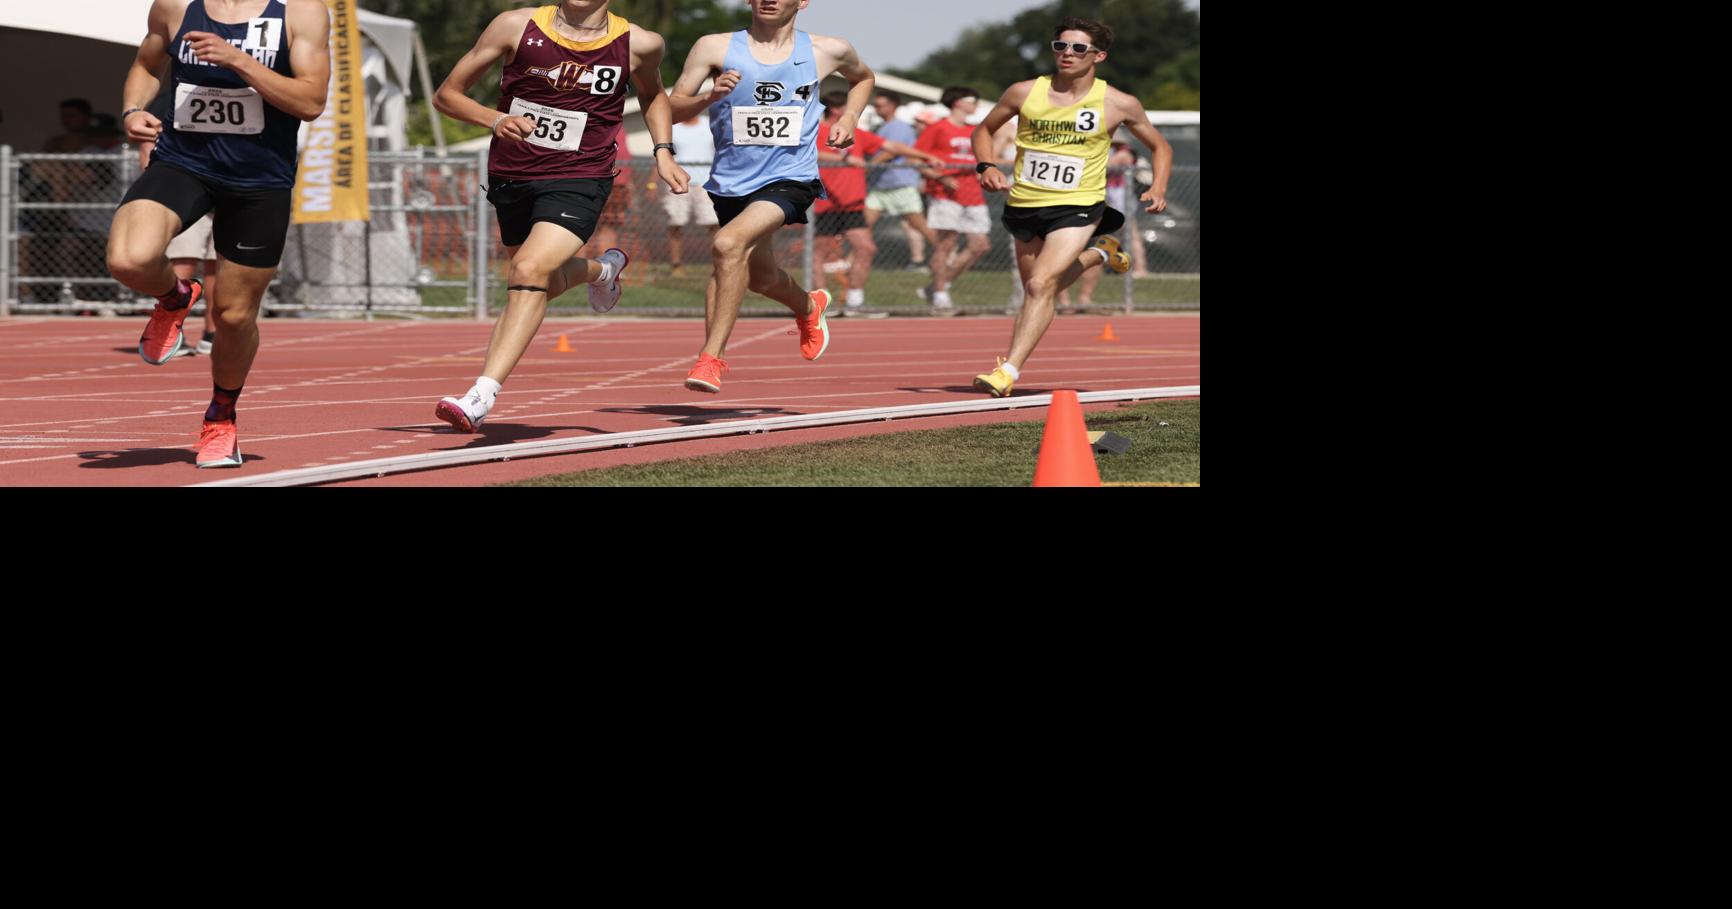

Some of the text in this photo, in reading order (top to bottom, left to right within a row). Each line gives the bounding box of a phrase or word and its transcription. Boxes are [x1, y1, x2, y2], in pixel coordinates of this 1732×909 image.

[254, 20, 270, 47] 1
[594, 68, 616, 93] 8
[795, 85, 810, 99] 4
[190, 98, 245, 125] 230
[1079, 111, 1095, 131] 3
[338, 122, 352, 141] DE
[747, 116, 790, 138] 532
[1032, 132, 1087, 145] CHRISTIAN
[1029, 160, 1076, 184] 1216
